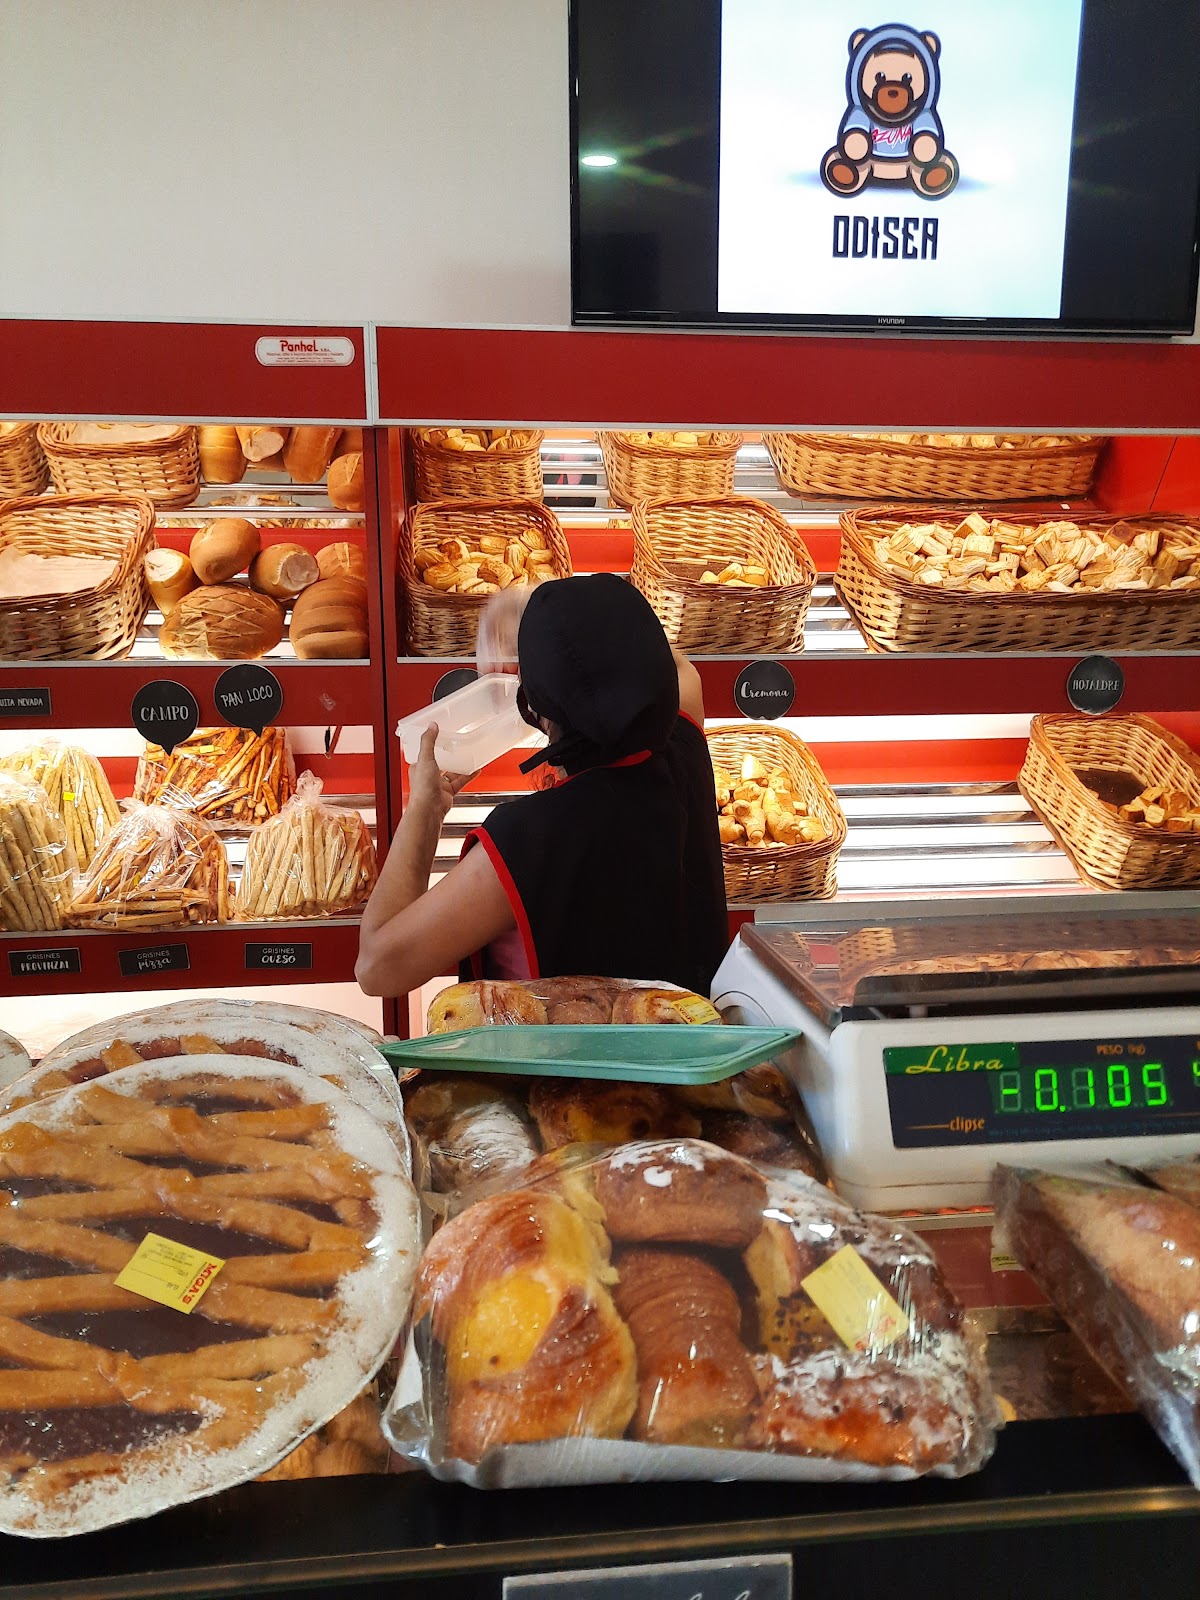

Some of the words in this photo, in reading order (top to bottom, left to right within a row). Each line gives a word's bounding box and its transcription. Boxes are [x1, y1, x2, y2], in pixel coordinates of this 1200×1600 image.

[832, 215, 939, 260] ODISEA
[877, 317, 906, 325] HYUNDAI
[279, 339, 319, 352] Panhel
[740, 681, 790, 699] Cremona
[1072, 679, 1120, 691] HOJALDRE
[17, 697, 44, 707] NEVADA
[220, 690, 244, 708] PAN
[246, 685, 273, 703] LOCO
[140, 705, 189, 722] CAMPO
[26, 952, 61, 960] GRISINES
[136, 949, 171, 960] GRISINES
[261, 954, 296, 964] QUESO
[137, 957, 172, 971] pizza
[905, 1045, 1004, 1074] Libra
[182, 1263, 218, 1305] MIGA'S
